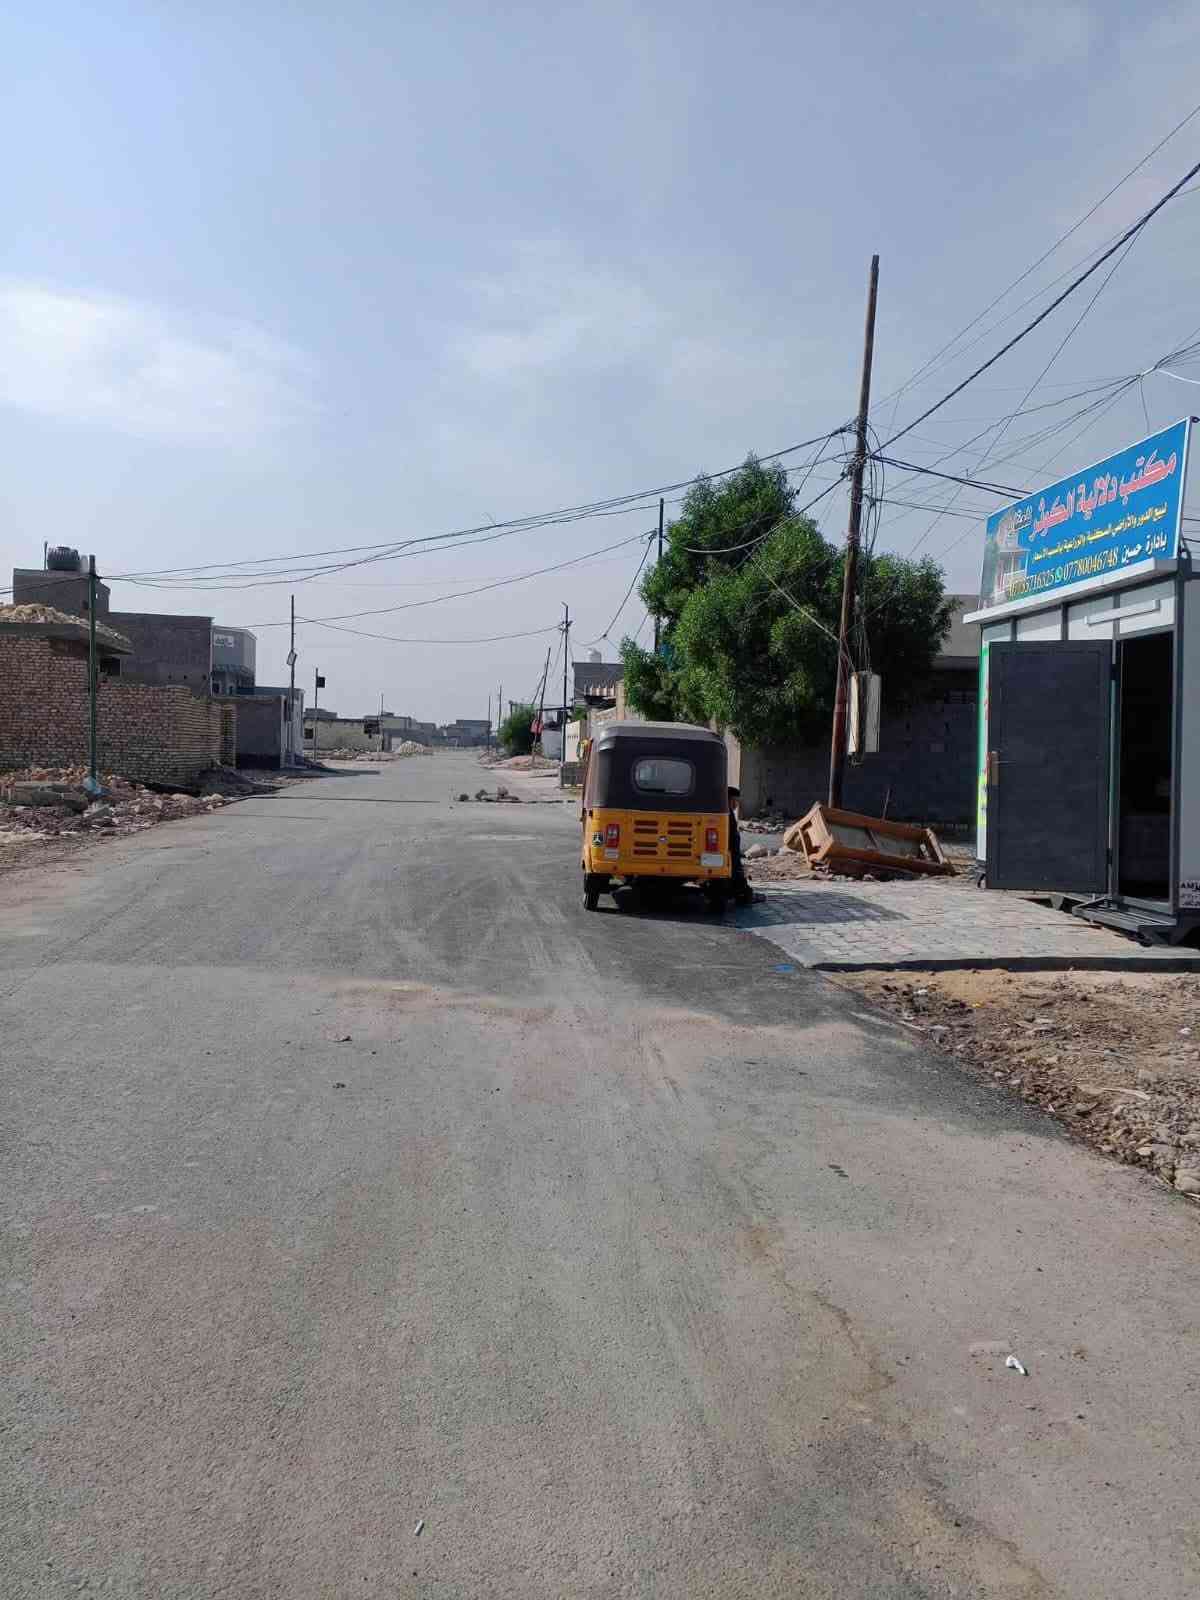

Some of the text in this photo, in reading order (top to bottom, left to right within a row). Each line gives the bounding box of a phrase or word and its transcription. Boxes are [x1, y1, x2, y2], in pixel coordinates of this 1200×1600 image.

[1120, 449, 1177, 505] مكتب
[1028, 487, 1075, 541] الكوثر
[1121, 543, 1142, 565] حسين
